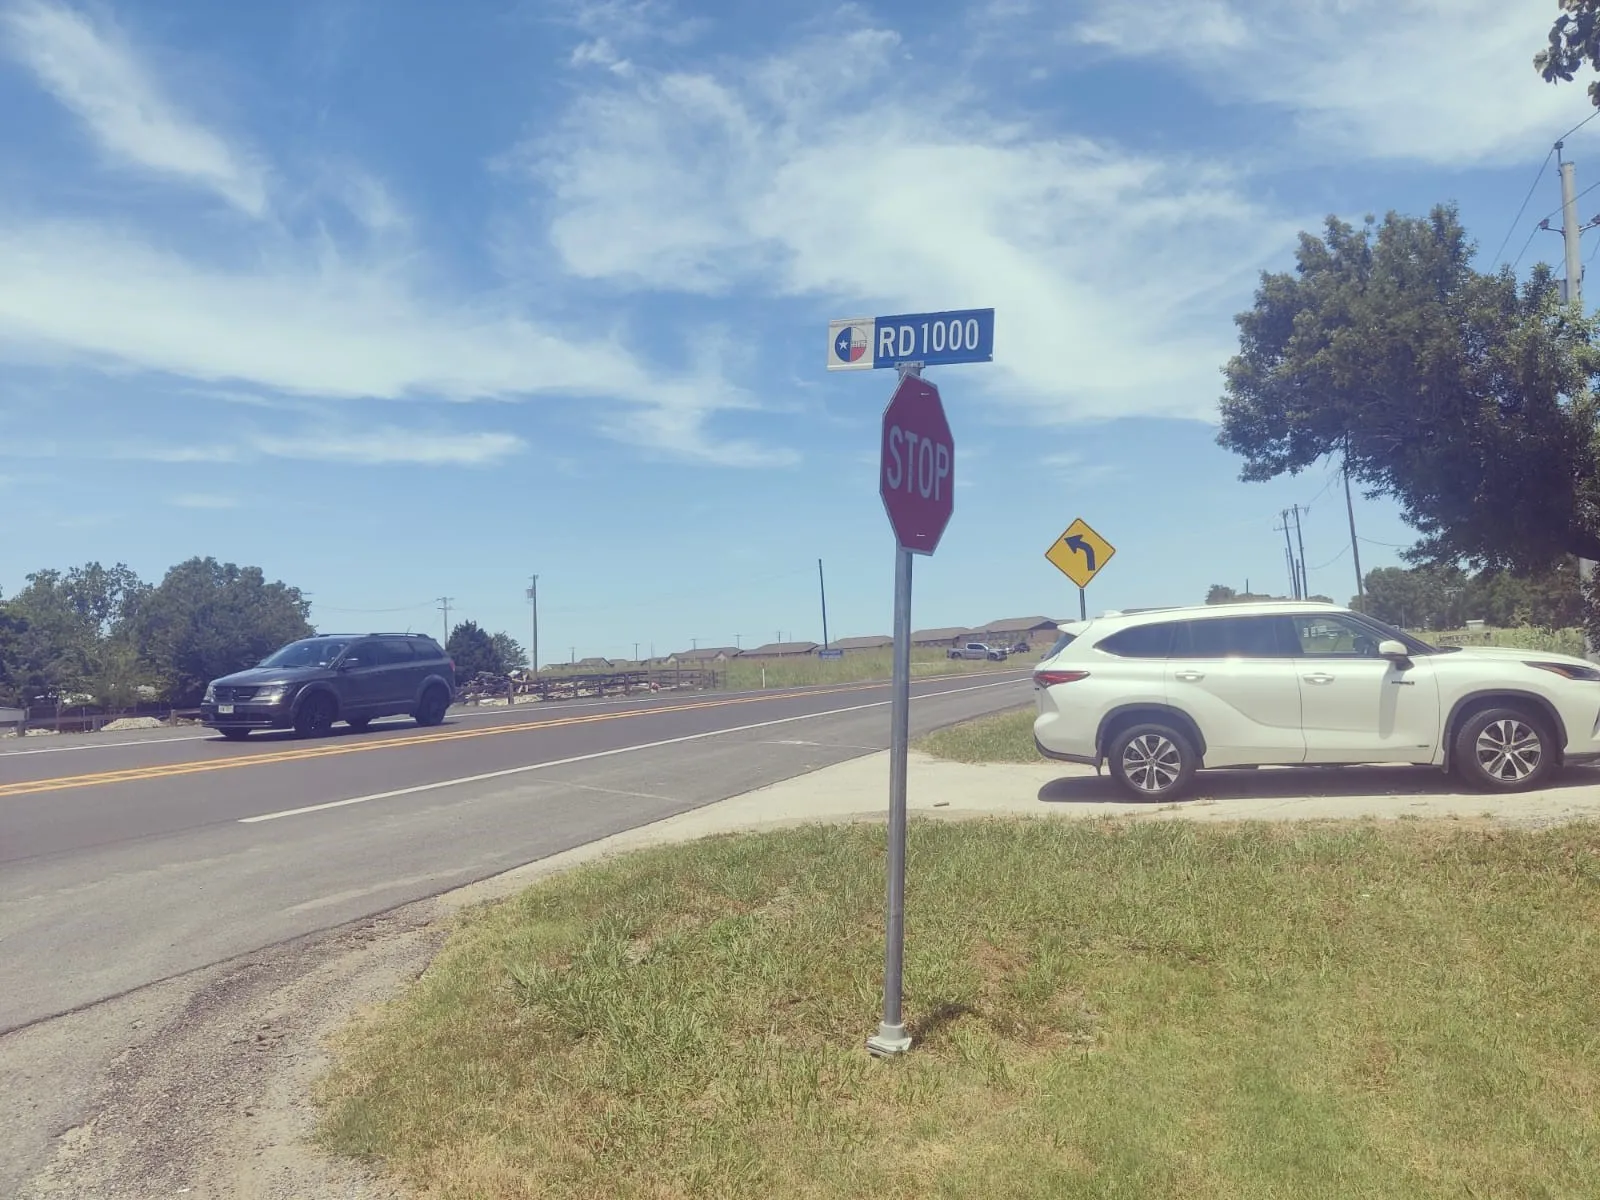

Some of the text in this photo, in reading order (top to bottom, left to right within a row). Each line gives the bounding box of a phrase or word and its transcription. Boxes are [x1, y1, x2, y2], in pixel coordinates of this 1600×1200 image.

[879, 319, 979, 358] RD 1000
[886, 424, 950, 502] STOP
